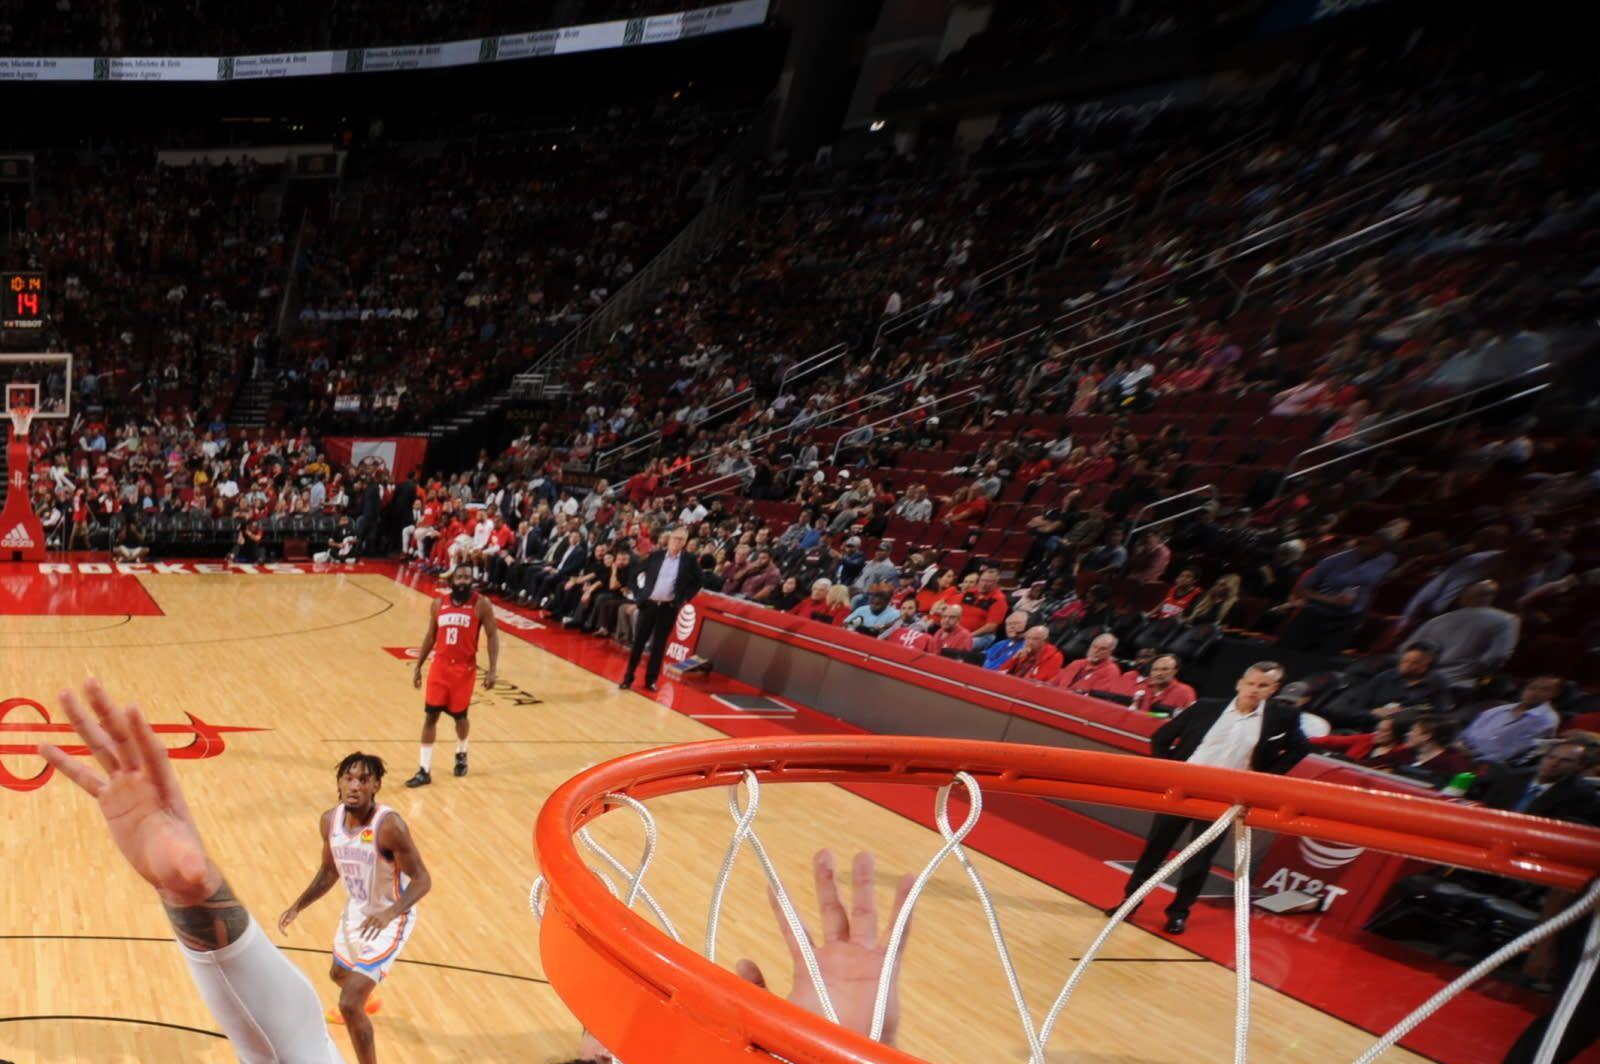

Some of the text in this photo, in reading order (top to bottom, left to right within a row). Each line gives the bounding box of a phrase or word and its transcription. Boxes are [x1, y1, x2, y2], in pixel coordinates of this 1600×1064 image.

[11, 276, 42, 292] 10:14
[18, 292, 37, 316] 14
[38, 563, 306, 575] ROCKETS
[446, 627, 458, 645] 13
[344, 875, 368, 901] 23
[1262, 867, 1349, 912] AT&T
